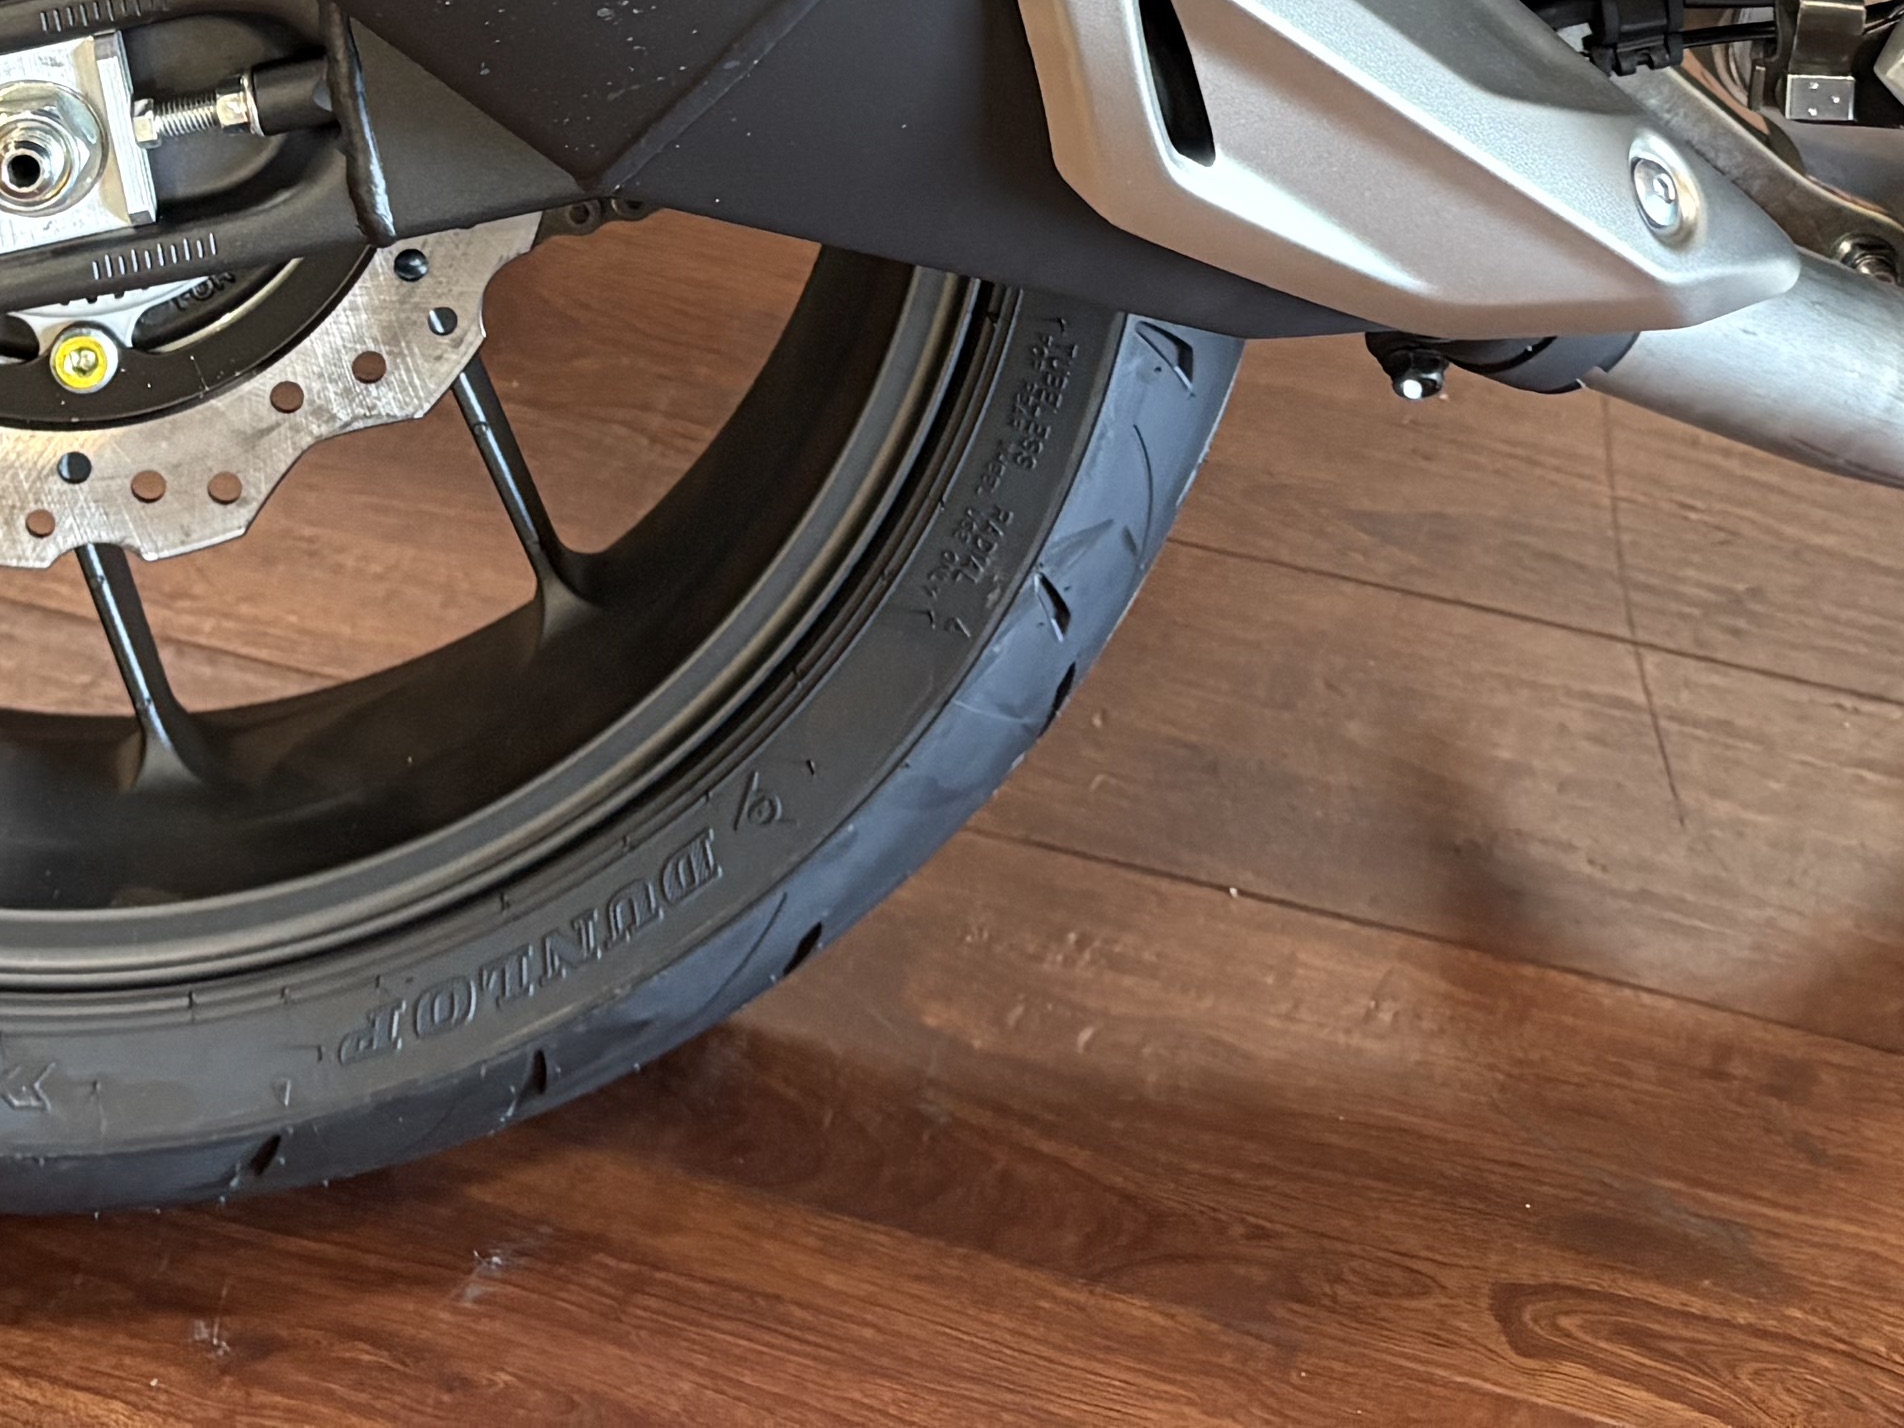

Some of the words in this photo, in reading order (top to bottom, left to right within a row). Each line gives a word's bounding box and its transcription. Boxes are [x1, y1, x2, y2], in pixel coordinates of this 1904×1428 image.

[1013, 346, 1079, 470] TUBELESS
[953, 503, 1014, 586] RADIAL
[334, 827, 720, 1066] DUNLOP
